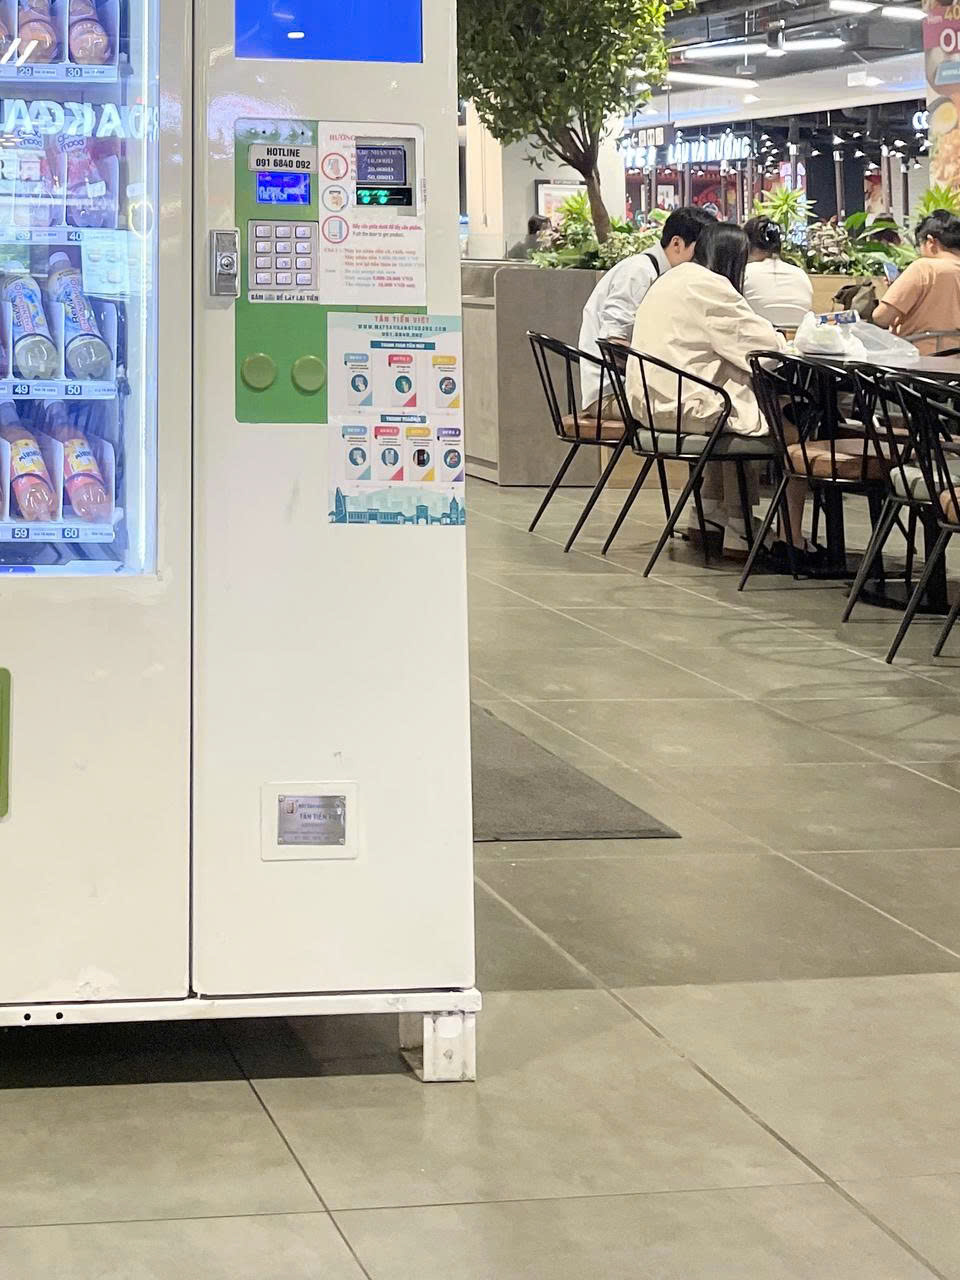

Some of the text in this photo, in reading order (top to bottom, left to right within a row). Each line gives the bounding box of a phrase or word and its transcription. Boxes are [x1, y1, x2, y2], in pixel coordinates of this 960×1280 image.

[19, 67, 32, 76] 29
[67, 68, 81, 77] 30
[267, 147, 300, 157] HOTLINE
[256, 158, 311, 169] 091 6840 092
[69, 232, 82, 241] 40
[14, 385, 28, 395] 49
[67, 385, 81, 395] 50
[13, 528, 28, 538] 59
[64, 528, 78, 538] 60
